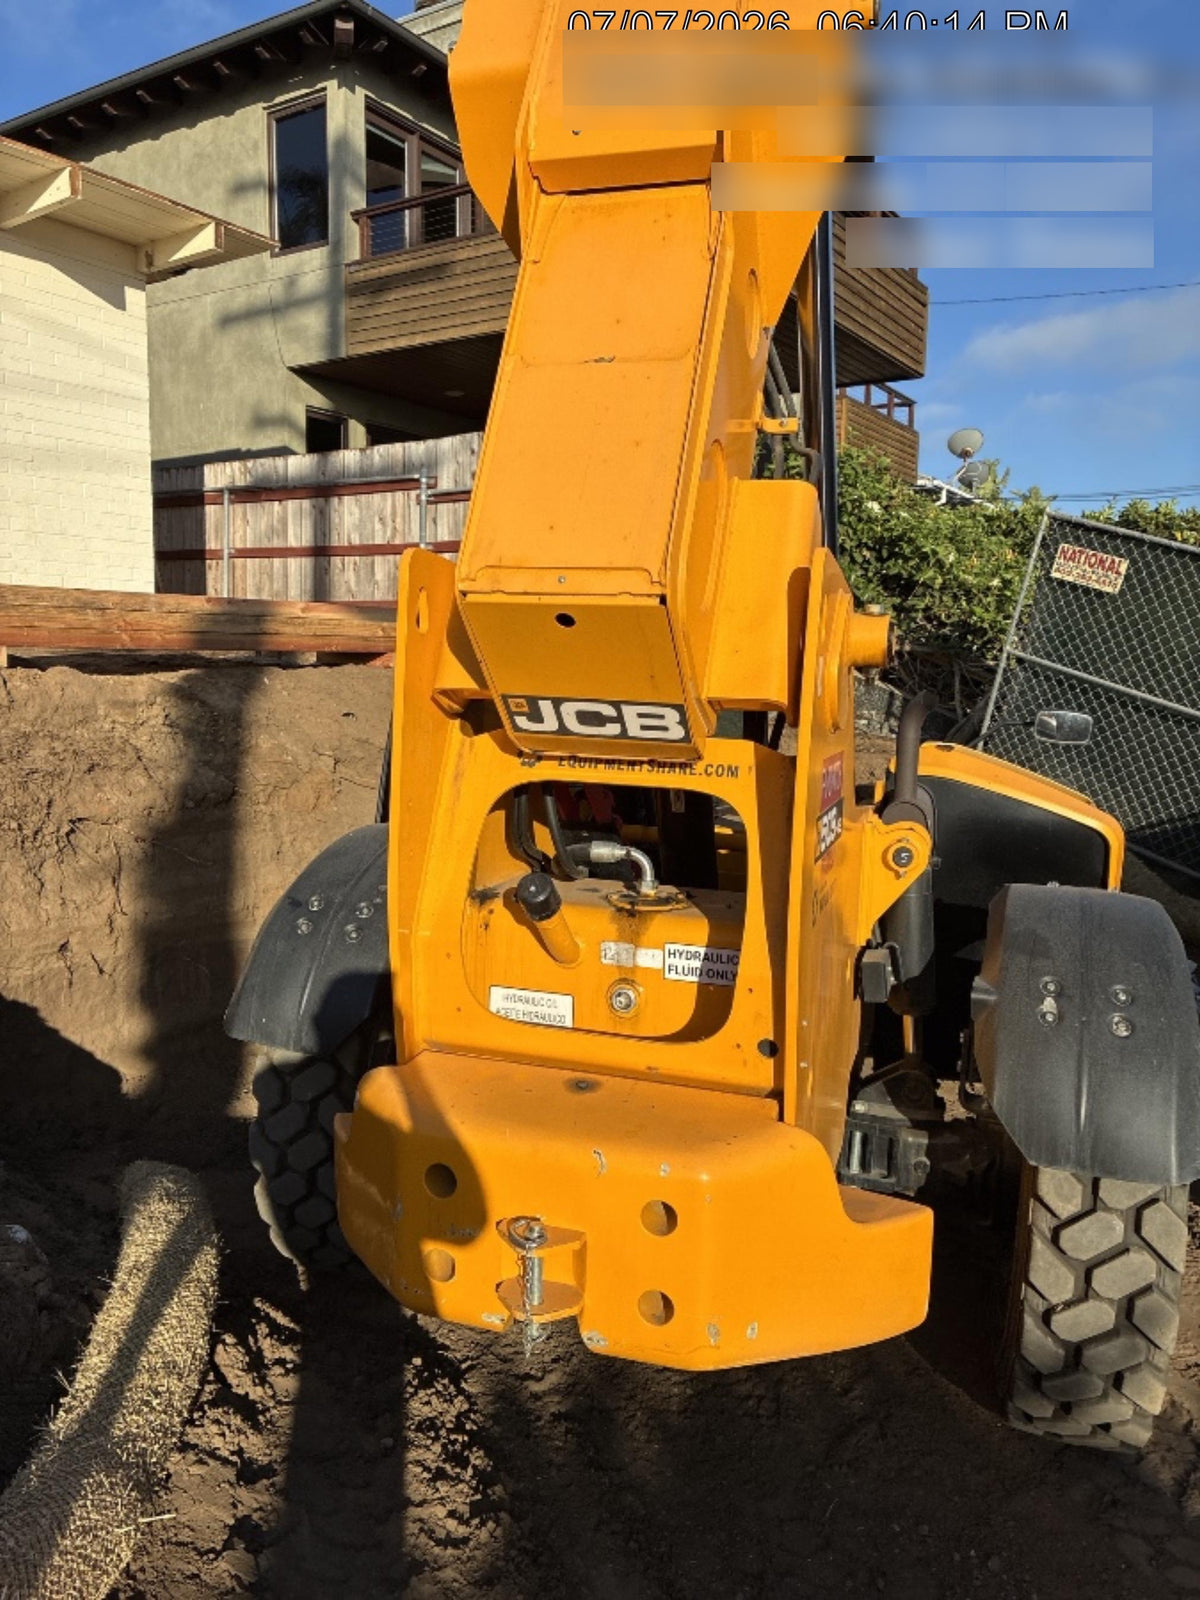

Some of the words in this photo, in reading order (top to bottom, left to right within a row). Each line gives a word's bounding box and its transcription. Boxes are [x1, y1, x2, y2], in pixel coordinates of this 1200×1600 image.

[1058, 545, 1122, 576] NATIONAL
[513, 699, 686, 741] JCB
[667, 948, 739, 966] HYDRAULIC
[667, 963, 703, 978] FLUID
[706, 968, 737, 981] ONLY
